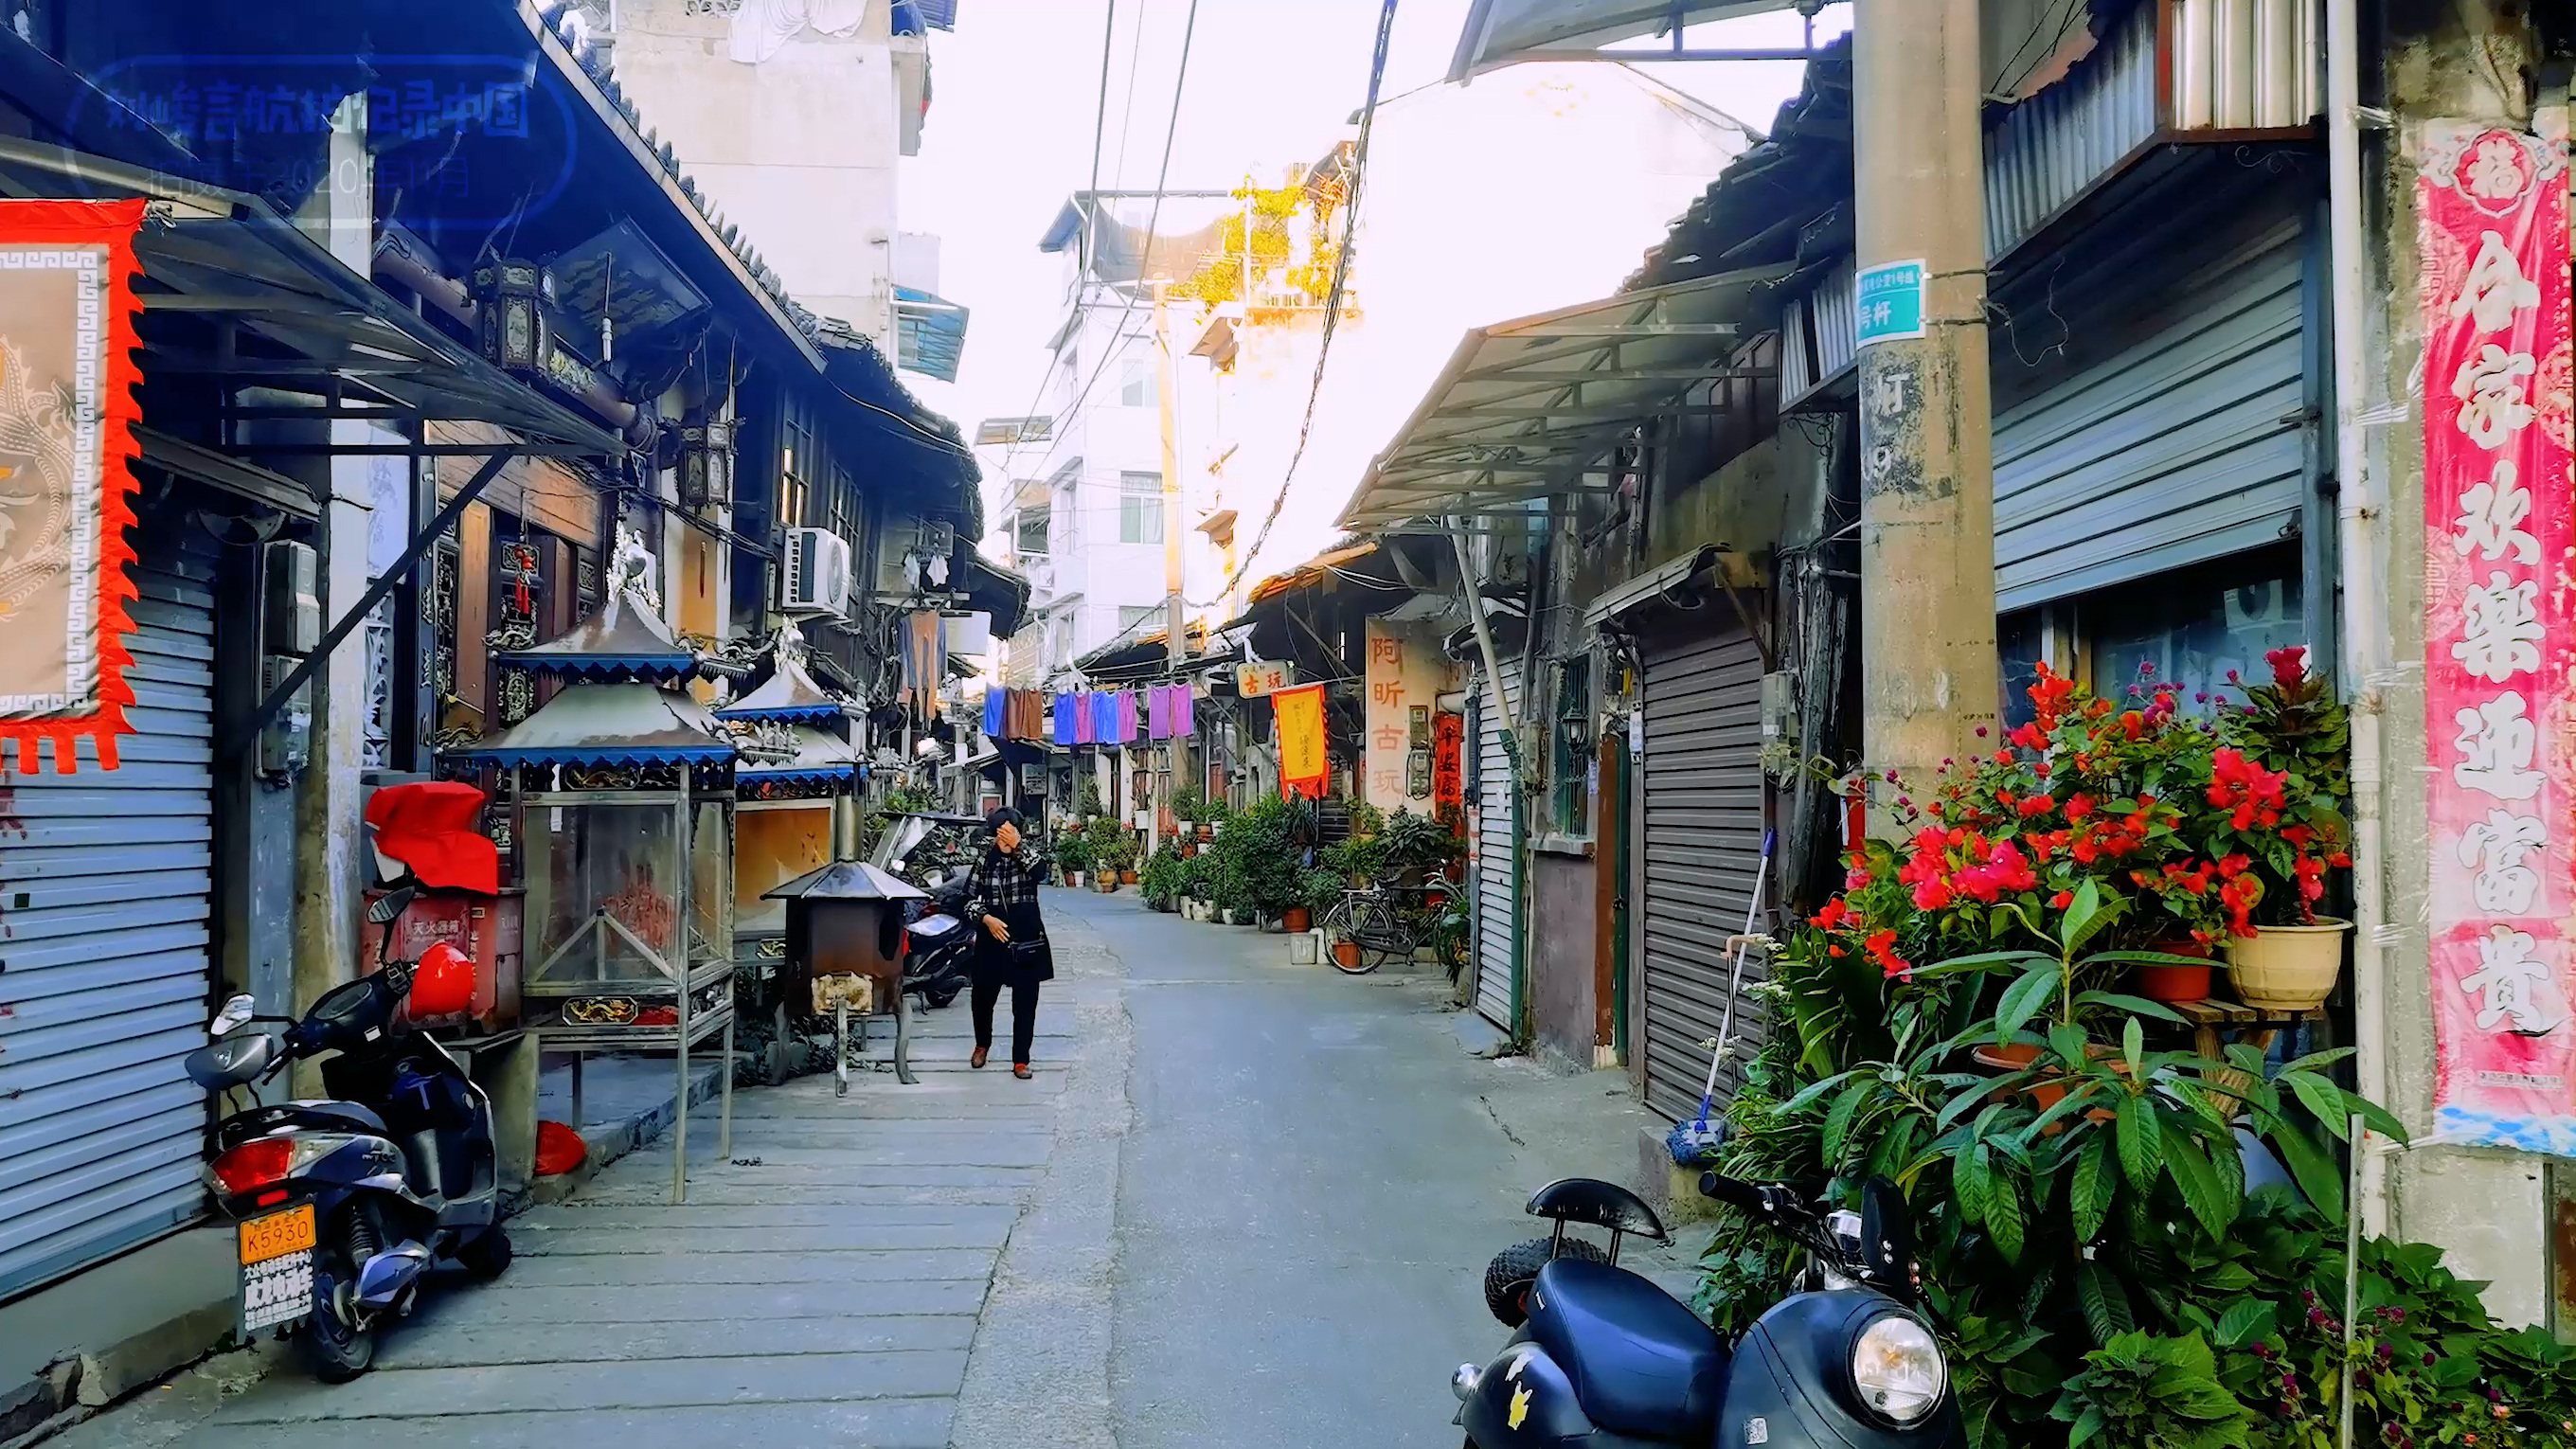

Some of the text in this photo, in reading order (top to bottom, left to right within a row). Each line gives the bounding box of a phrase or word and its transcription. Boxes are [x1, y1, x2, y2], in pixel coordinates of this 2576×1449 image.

[1243, 671, 1286, 695] 古玩
[1370, 637, 1406, 796] 阿昕古玩
[248, 1220, 309, 1253] K5930
